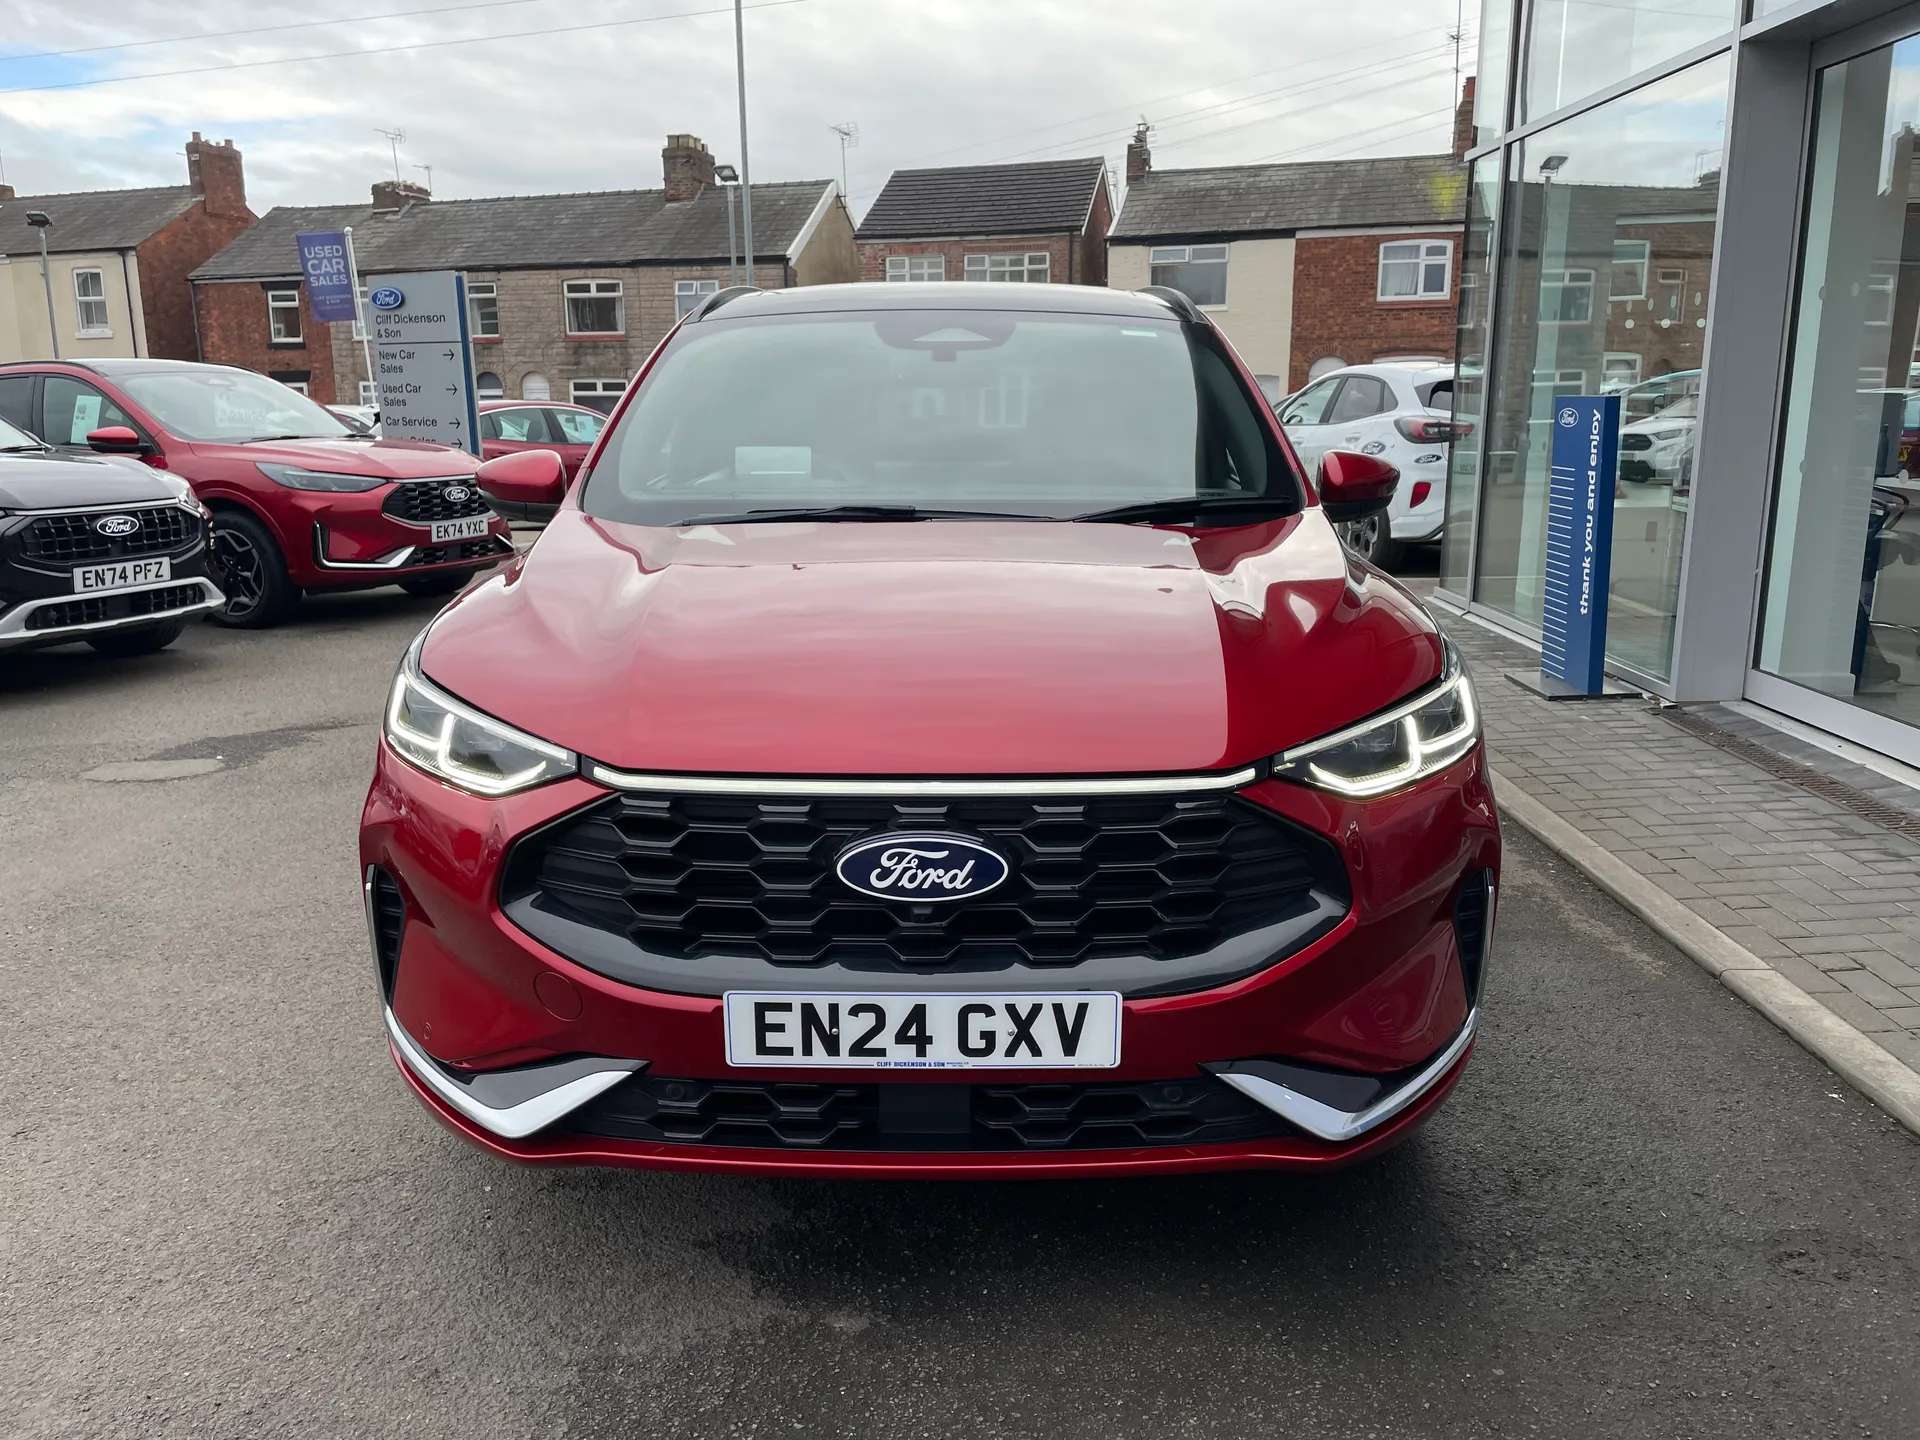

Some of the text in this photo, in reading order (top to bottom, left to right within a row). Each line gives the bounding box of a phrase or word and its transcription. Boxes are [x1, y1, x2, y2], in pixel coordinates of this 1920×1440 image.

[304, 245, 342, 258] USED
[308, 258, 345, 274] CAR
[310, 274, 348, 287] SALES
[393, 313, 446, 324] Dickenson
[384, 328, 402, 338] Son
[379, 349, 416, 361] New Car
[380, 363, 404, 374] Sales
[382, 382, 421, 393] Used Car
[383, 397, 407, 407] Sales
[385, 416, 438, 427] Car Service
[1579, 408, 1601, 615] thank you and enjoy
[105, 519, 132, 533] Ford
[436, 520, 485, 539] EK74 YXC
[82, 561, 163, 588] EN74 PFZ
[869, 848, 976, 890] Ford
[754, 1001, 1089, 1058] EN24 GXV
